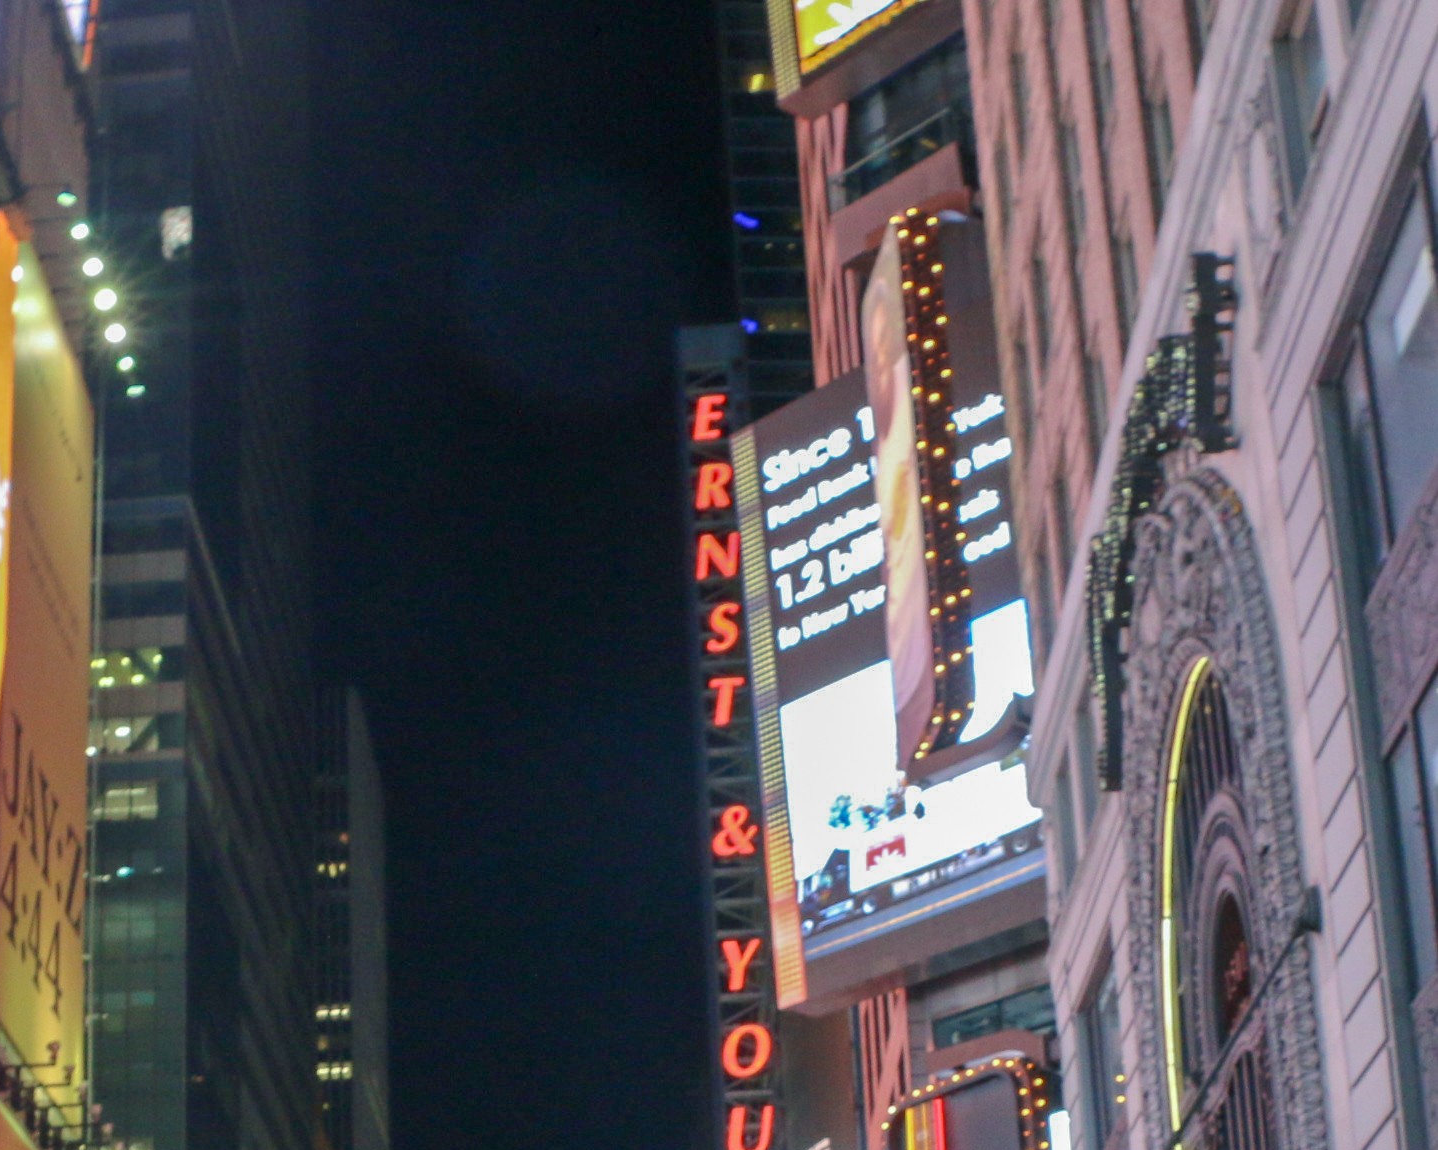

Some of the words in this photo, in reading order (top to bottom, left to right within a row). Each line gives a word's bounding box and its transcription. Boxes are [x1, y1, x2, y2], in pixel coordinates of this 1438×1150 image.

[762, 427, 852, 492] Since
[691, 393, 746, 728] ERNST
[711, 804, 759, 858] &
